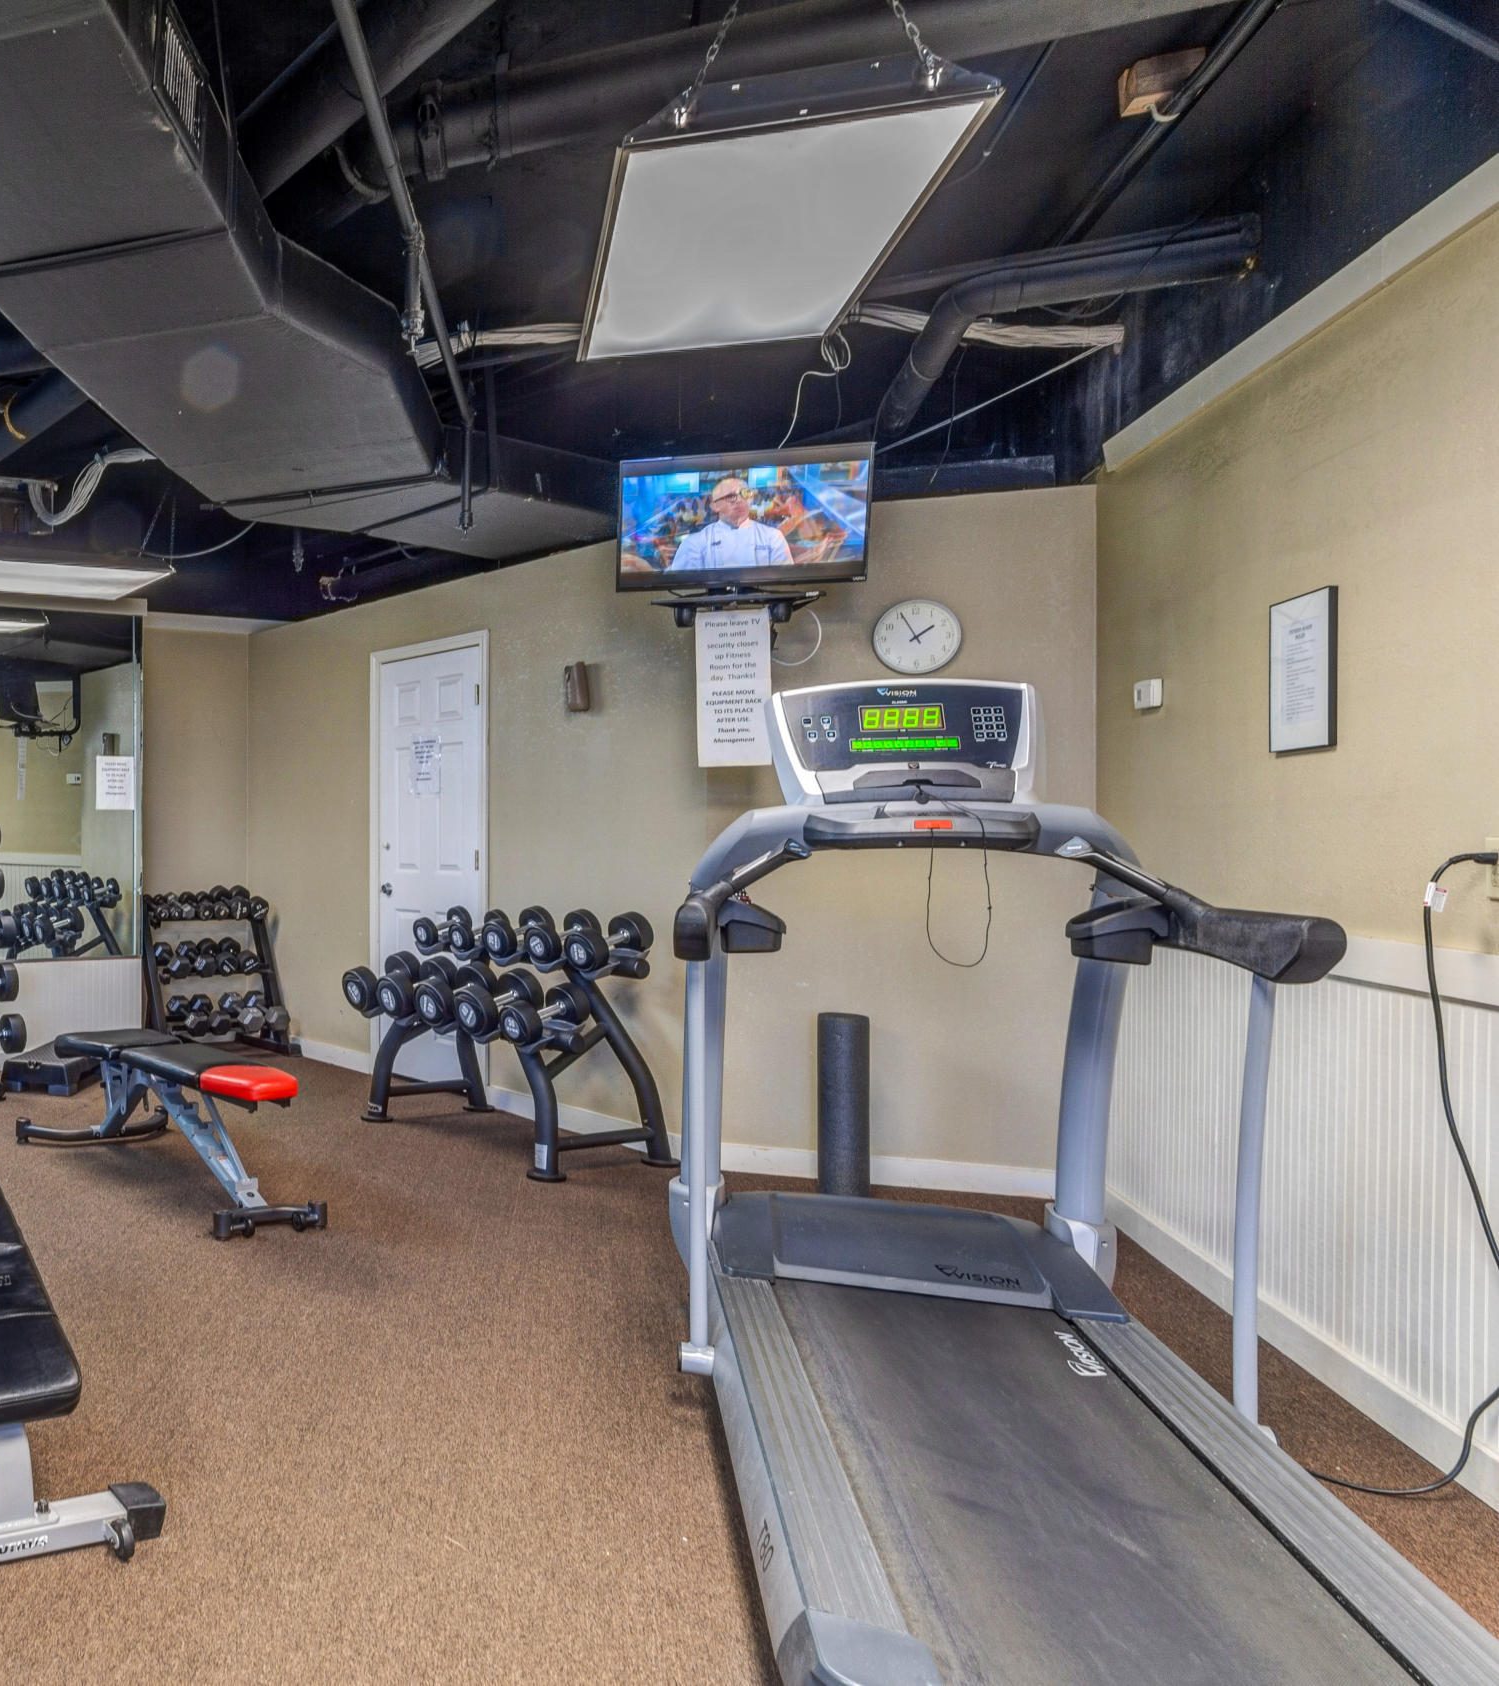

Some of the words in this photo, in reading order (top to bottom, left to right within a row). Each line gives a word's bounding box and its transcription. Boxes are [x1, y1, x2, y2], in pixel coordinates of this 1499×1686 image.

[704, 620, 728, 628] Please
[729, 619, 749, 627] leave
[732, 662, 743, 670] for
[744, 661, 757, 669] the
[727, 671, 757, 681] Thanks!
[952, 1270, 1021, 1287] VISION
[1053, 1330, 1108, 1377] VISION
[756, 1517, 774, 1573] T80
